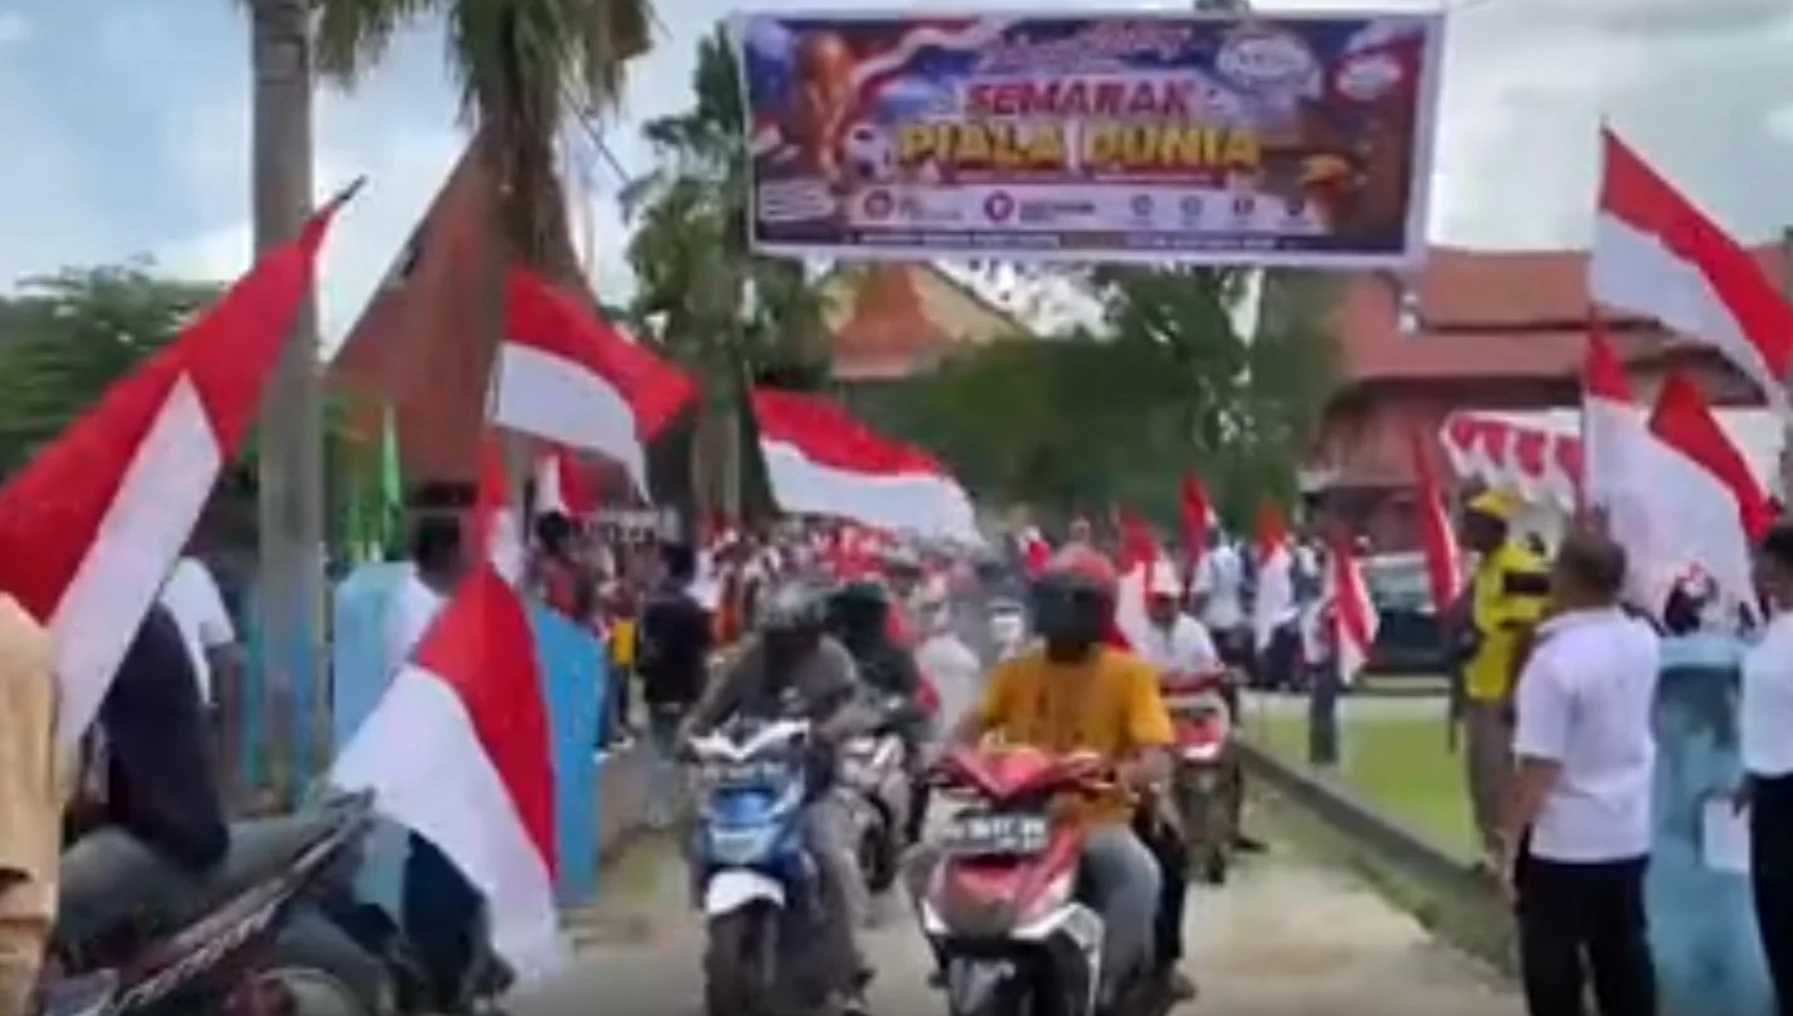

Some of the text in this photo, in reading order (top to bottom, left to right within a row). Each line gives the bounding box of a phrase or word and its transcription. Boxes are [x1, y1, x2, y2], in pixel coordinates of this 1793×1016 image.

[965, 79, 1197, 118] SEMARAK
[896, 121, 1263, 171] PIALA DUNIA
